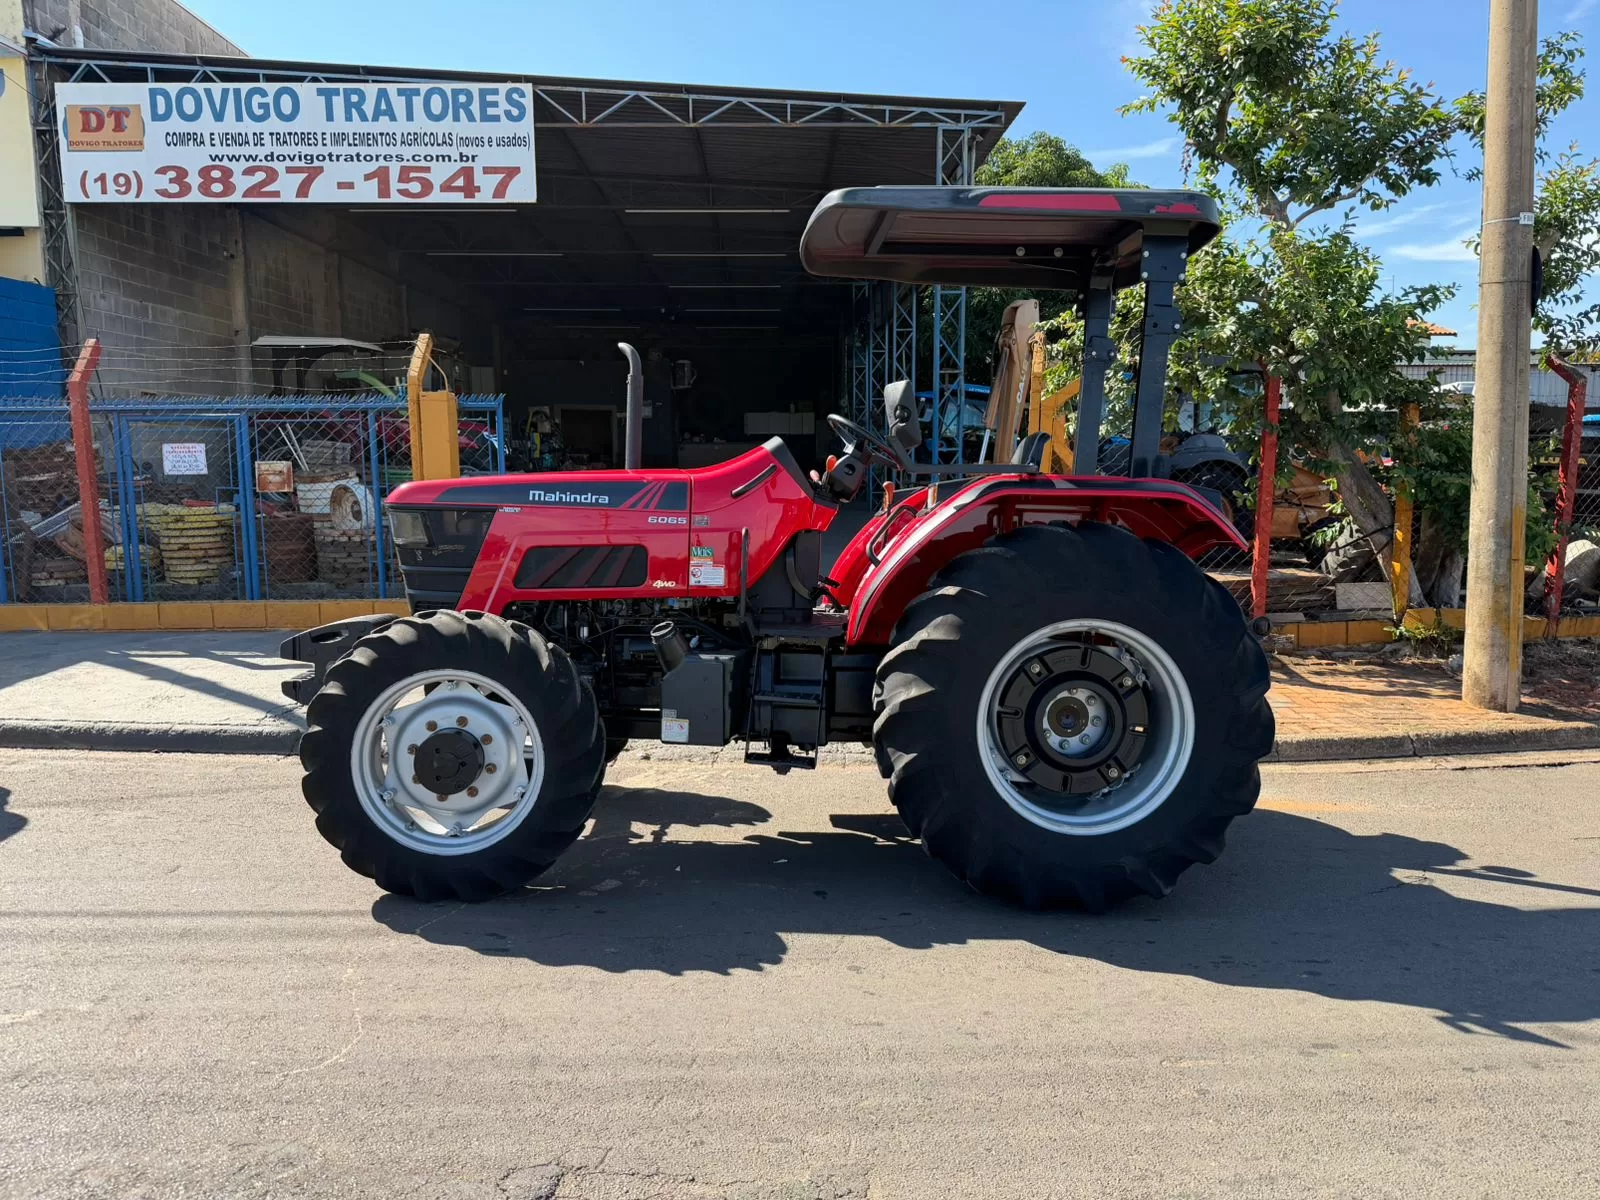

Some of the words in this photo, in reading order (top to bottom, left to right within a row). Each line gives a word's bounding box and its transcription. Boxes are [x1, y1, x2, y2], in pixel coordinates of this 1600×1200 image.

[148, 86, 301, 123] DOVIGO
[316, 86, 527, 123] TRATORES
[79, 106, 131, 133] DT
[165, 132, 205, 147] COMPRA
[209, 132, 216, 147] E
[218, 132, 250, 147] VENDA
[252, 132, 265, 147] DE
[269, 132, 319, 147] TRATORES
[321, 132, 327, 147] E
[330, 131, 398, 147] IMPLEMENTOS
[456, 132, 485, 151] (novos
[487, 137, 494, 148] e
[495, 132, 531, 152] usados)
[209, 151, 479, 164] www.dovigotratores.com.br
[79, 169, 144, 199] (19)
[529, 489, 610, 505] Mahindra
[647, 516, 687, 525] 6065
[653, 580, 676, 588] 4WD
